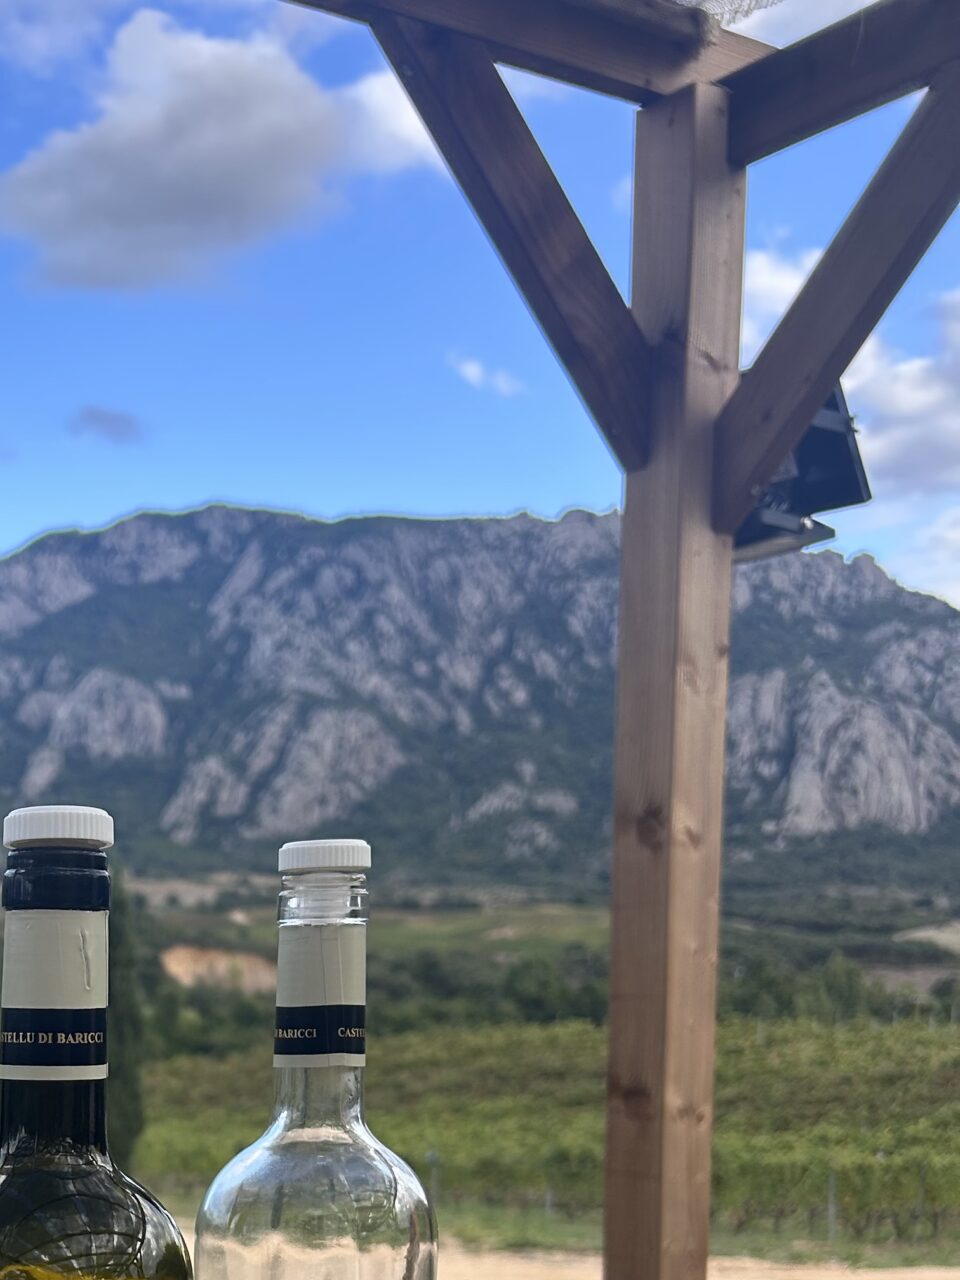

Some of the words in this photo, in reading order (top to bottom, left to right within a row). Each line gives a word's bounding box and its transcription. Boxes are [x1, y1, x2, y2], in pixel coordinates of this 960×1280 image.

[38, 1032, 53, 1044] DI
[57, 1032, 104, 1044] BARICCI
[279, 1028, 317, 1039] BARICCI
